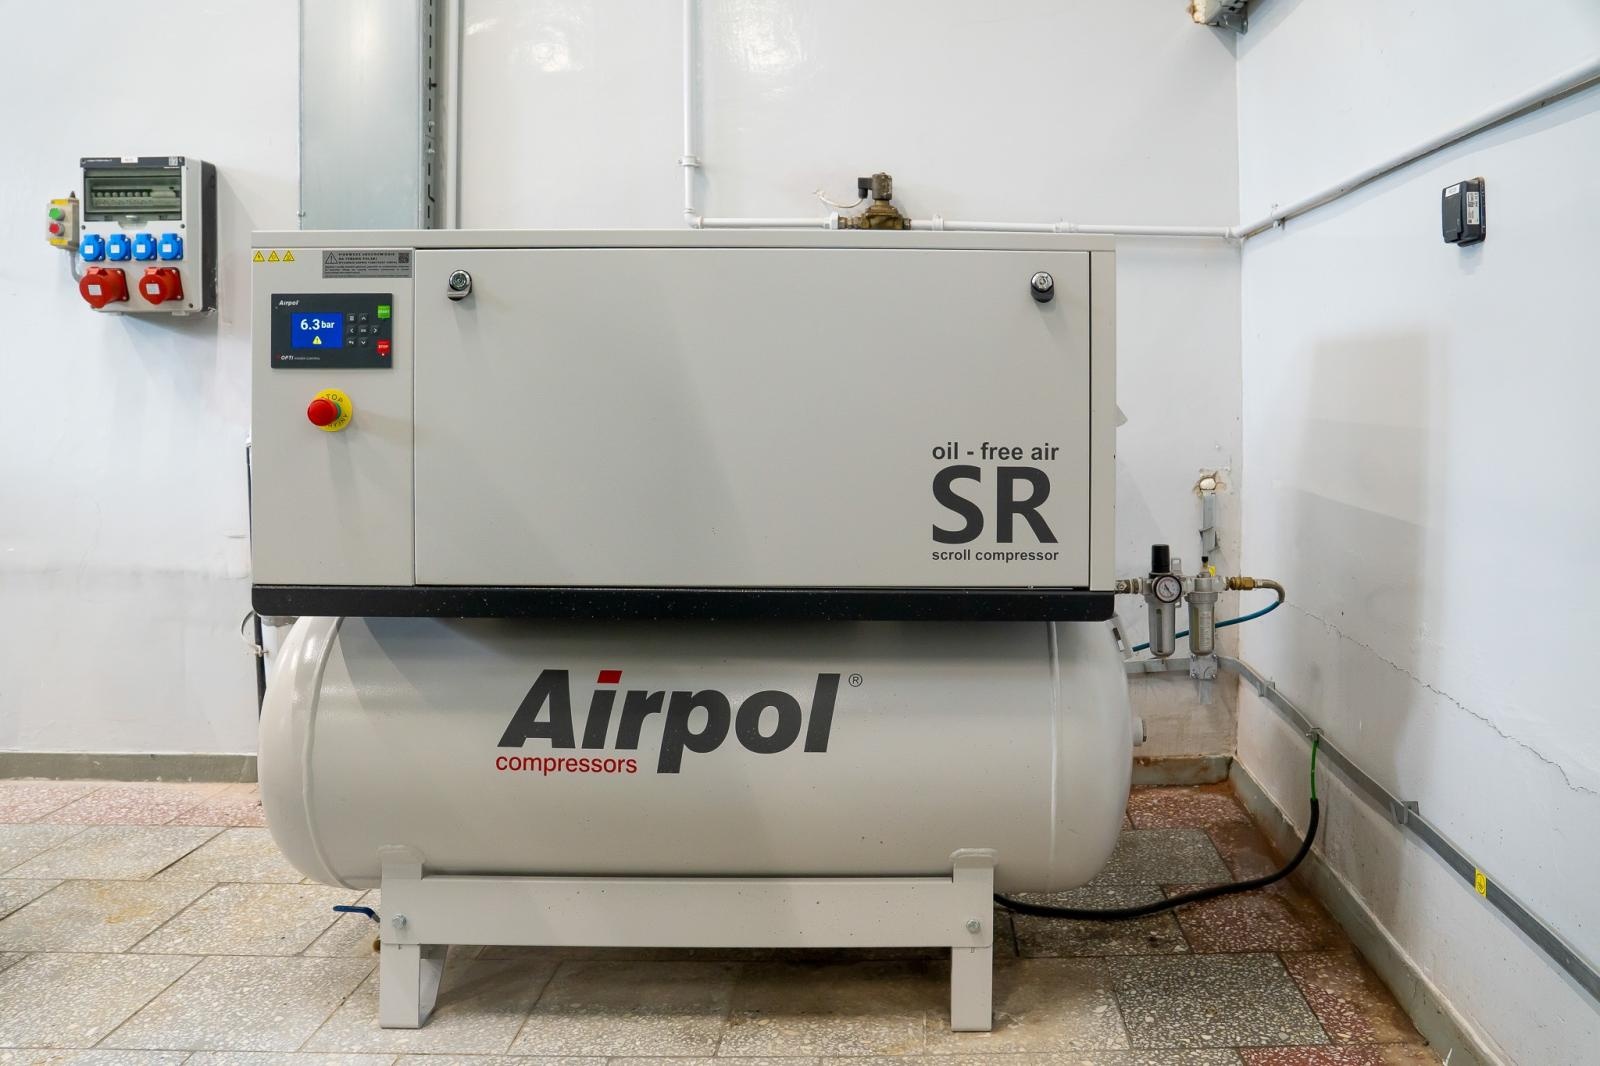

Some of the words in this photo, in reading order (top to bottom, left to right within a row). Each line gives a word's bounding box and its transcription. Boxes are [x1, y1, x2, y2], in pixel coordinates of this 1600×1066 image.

[300, 318, 320, 330] 6.3
[321, 320, 335, 329] bar
[932, 442, 959, 460] oil
[980, 442, 1023, 460] free
[1031, 442, 1060, 461] air
[932, 464, 1059, 544] SR
[932, 549, 971, 561] scroll
[975, 551, 1059, 563] compressor
[496, 669, 841, 774] Airpol
[495, 754, 638, 776] compressors
